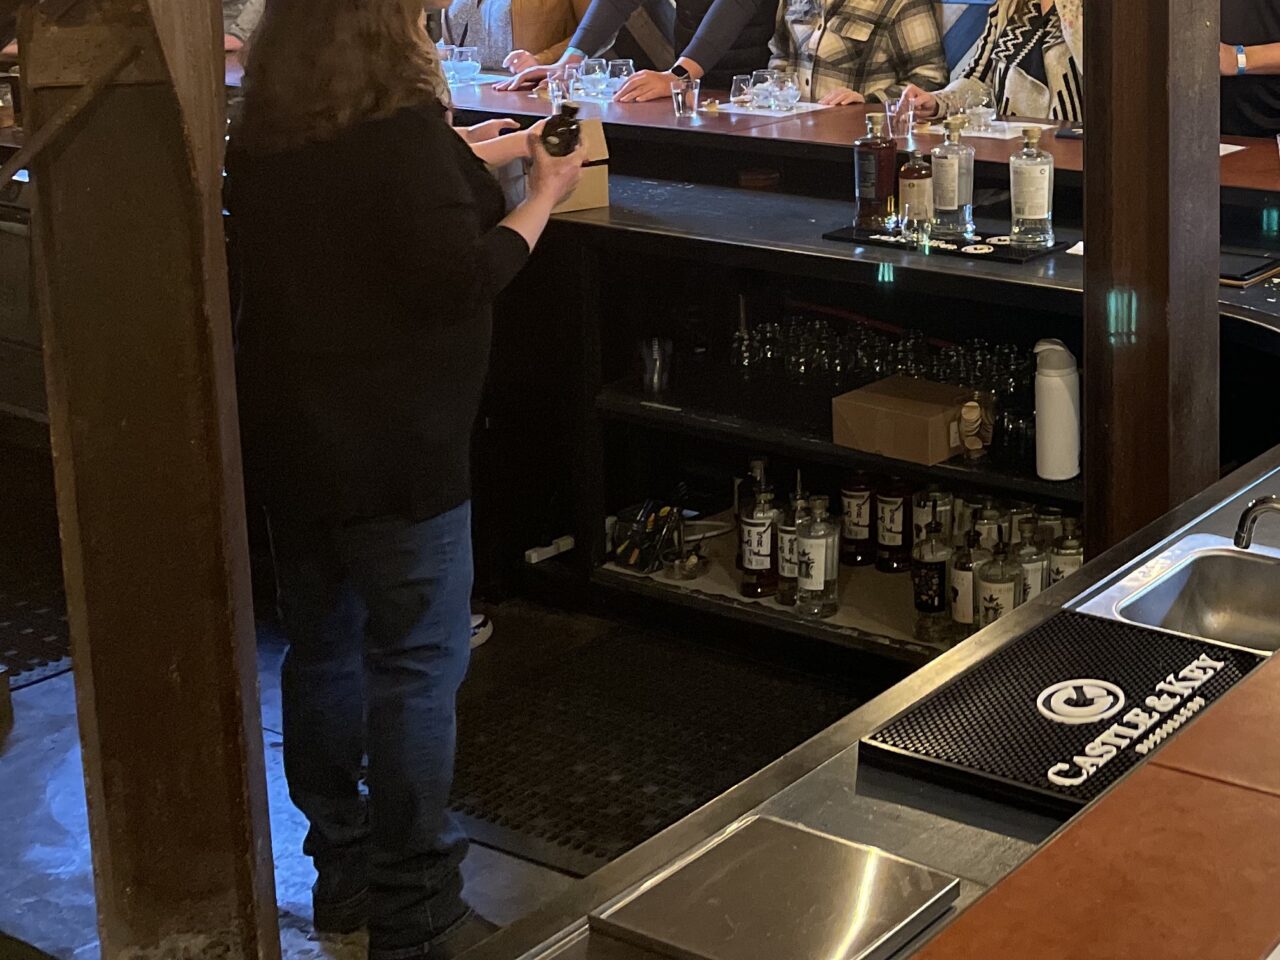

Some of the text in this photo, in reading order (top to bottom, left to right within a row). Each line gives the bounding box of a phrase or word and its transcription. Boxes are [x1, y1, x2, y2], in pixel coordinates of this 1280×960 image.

[1047, 653, 1225, 786] CASTLE & KEY
